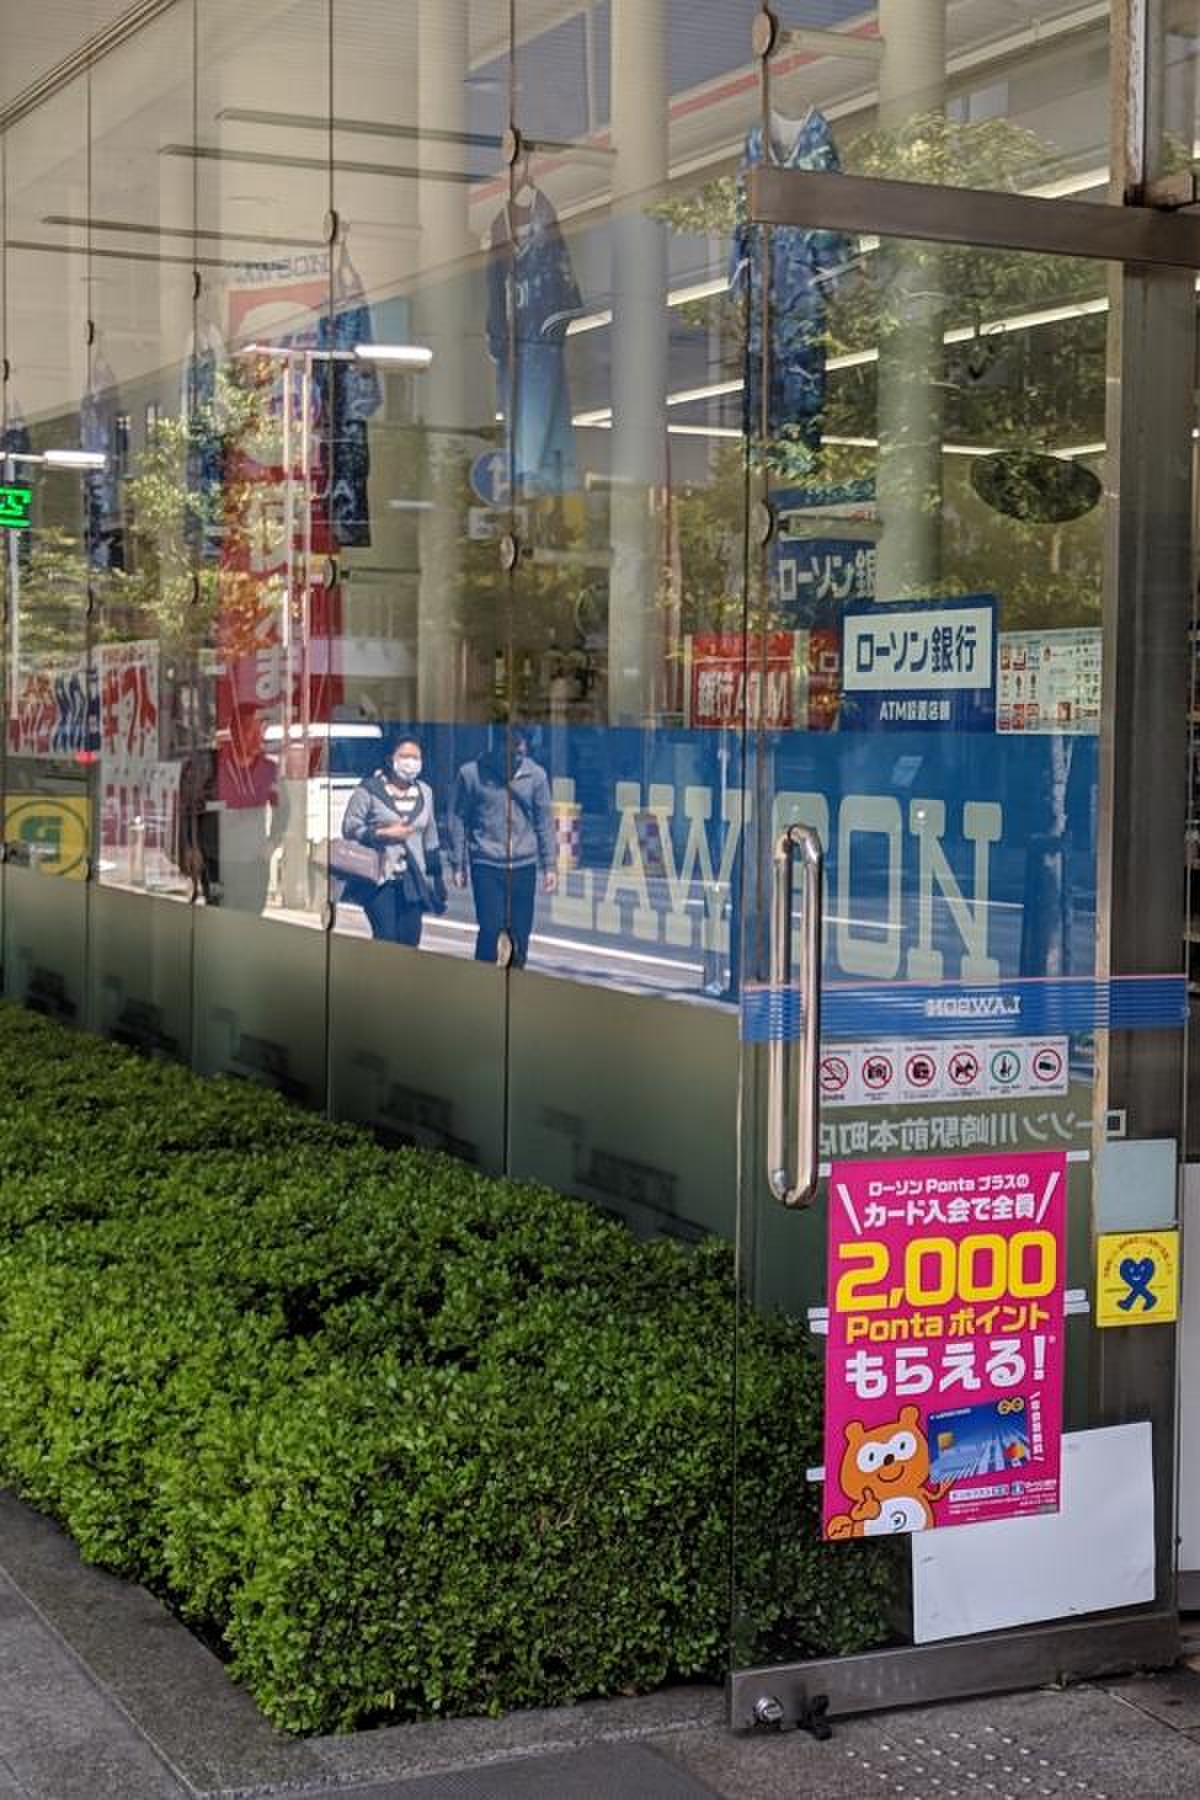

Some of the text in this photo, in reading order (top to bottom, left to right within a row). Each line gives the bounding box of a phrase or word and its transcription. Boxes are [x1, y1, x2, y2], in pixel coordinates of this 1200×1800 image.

[856, 624, 977, 673] ローソン銀行
[868, 1174, 1030, 1196] ローソン Ponta プラスの
[863, 1192, 1036, 1226] カード入会で全員
[836, 1231, 1057, 1313] 2,000
[846, 1306, 1050, 1345] Ponta ポイント
